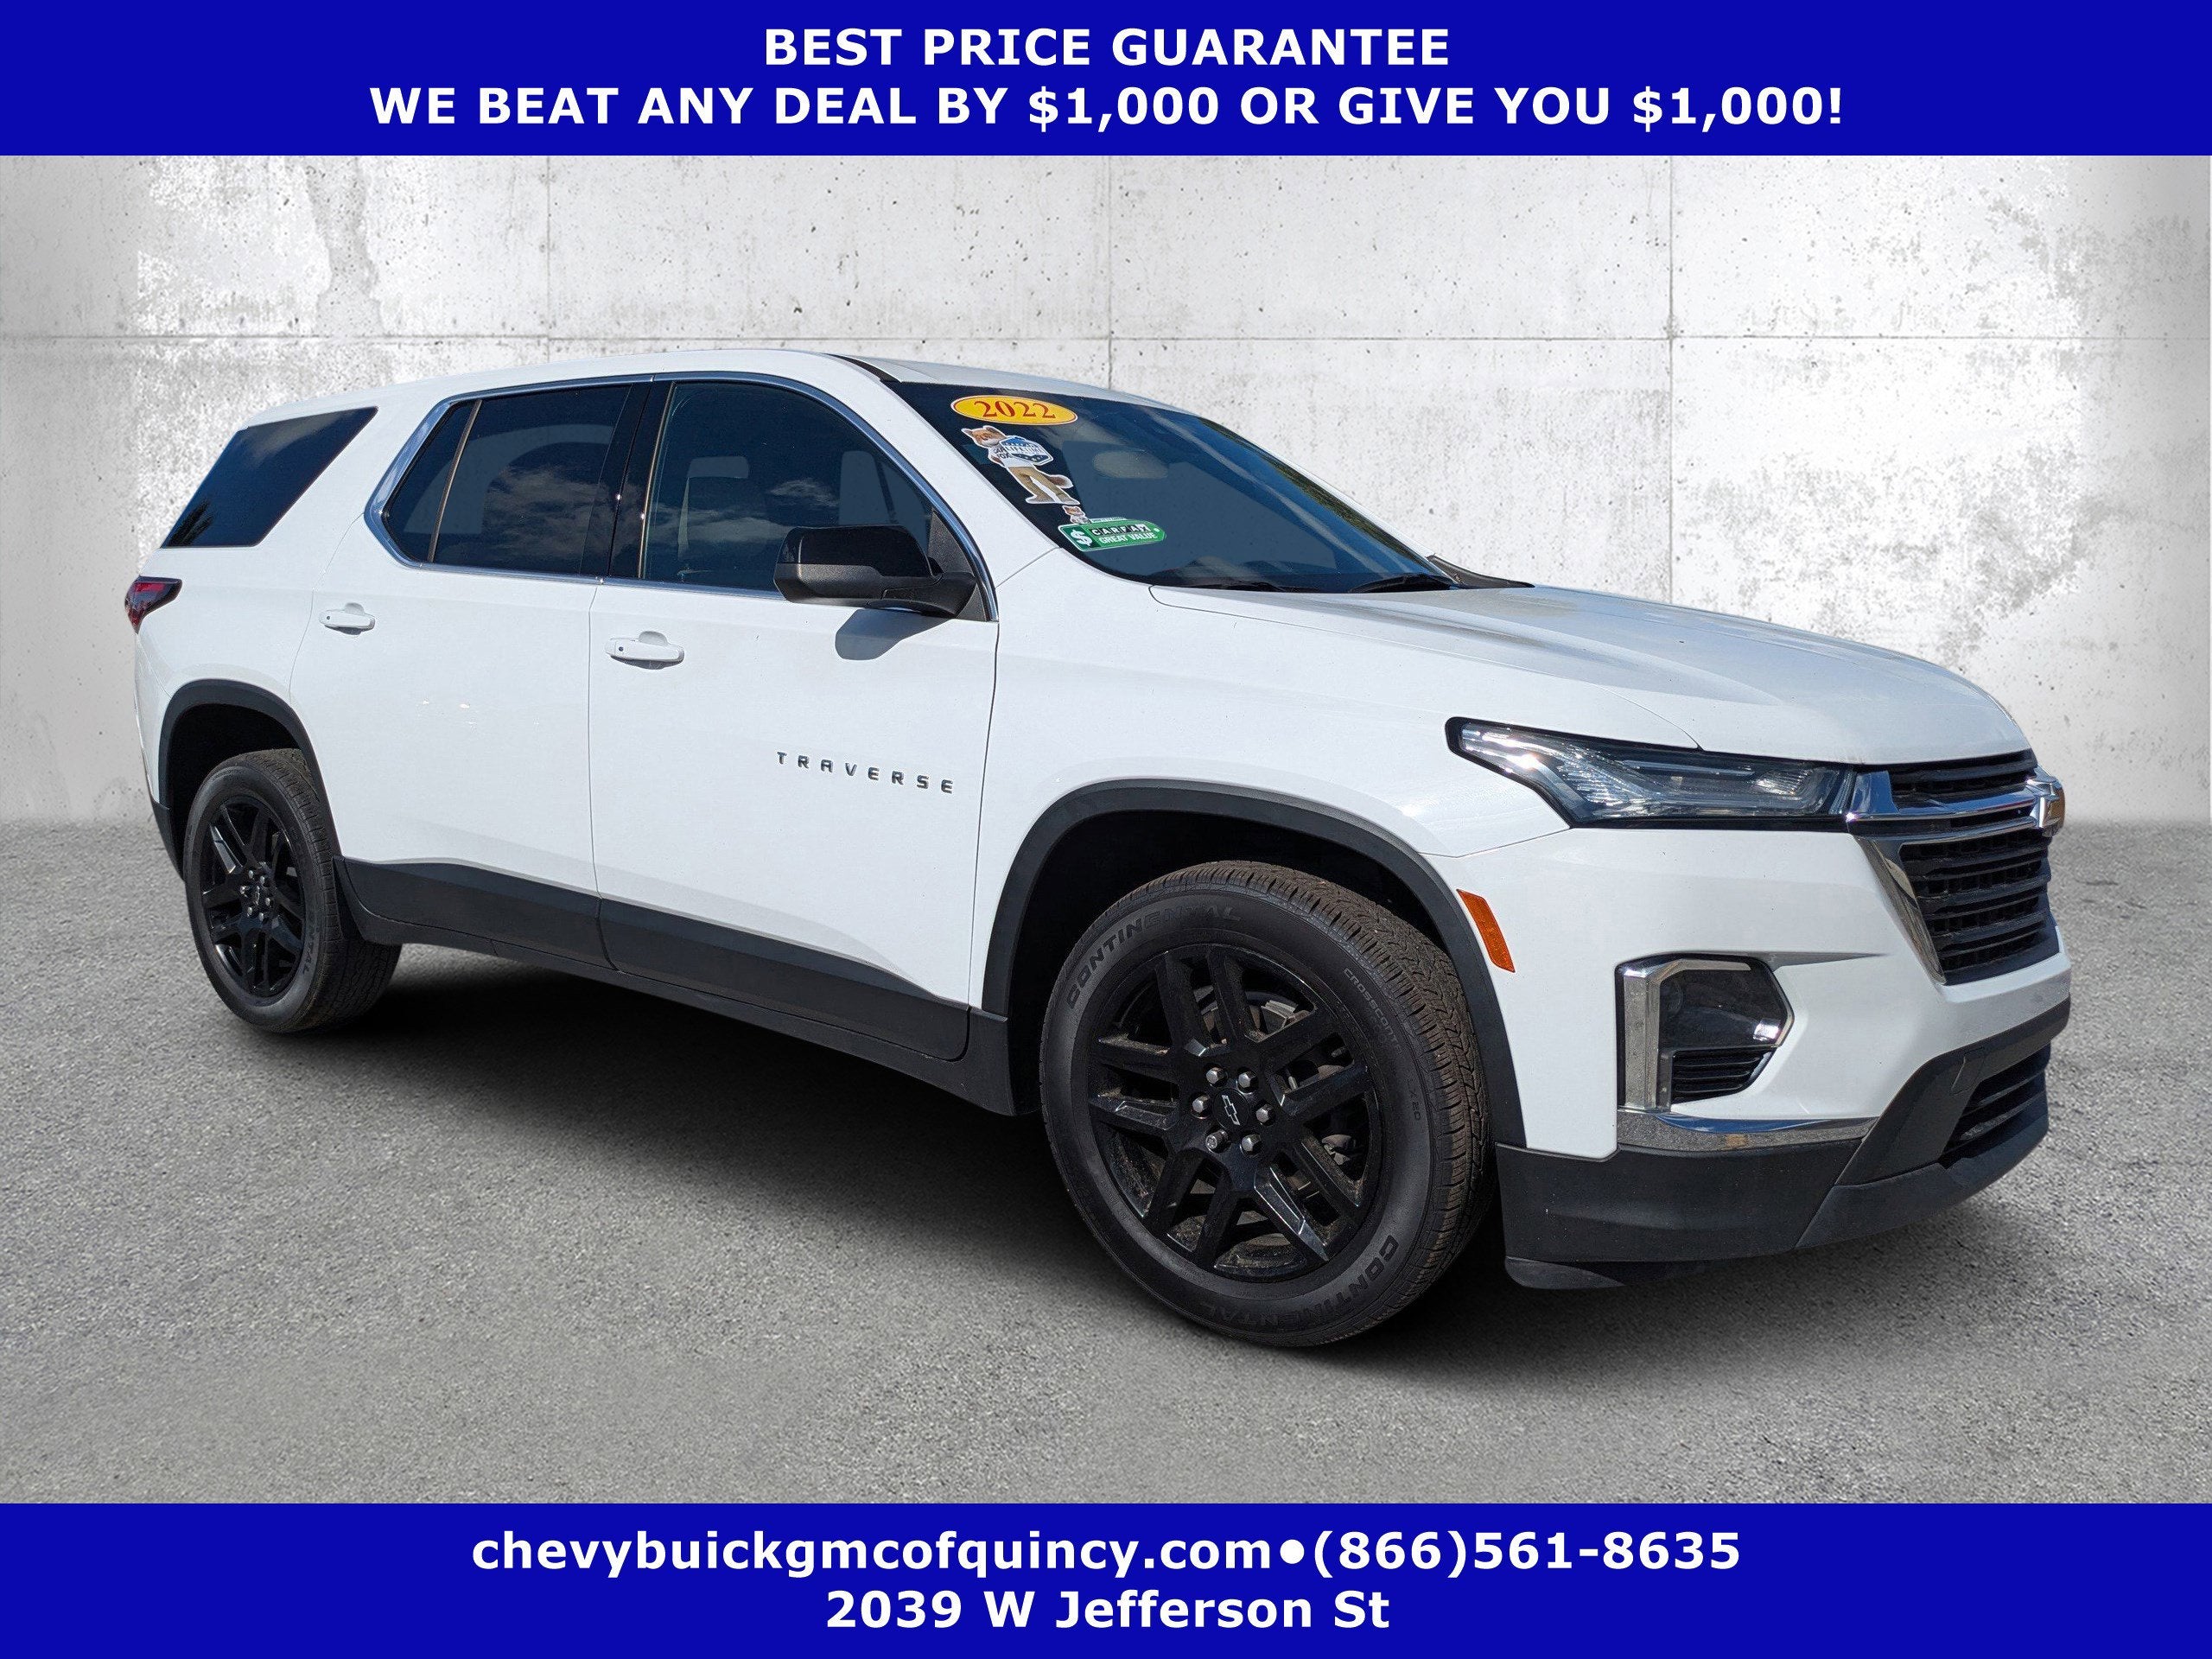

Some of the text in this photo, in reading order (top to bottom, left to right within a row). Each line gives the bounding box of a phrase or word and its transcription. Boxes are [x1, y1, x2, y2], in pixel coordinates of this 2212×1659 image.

[973, 399, 1057, 419] 2022
[1090, 524, 1151, 536] CARFAX
[1098, 532, 1158, 544] GREAT VALUE
[777, 752, 953, 794] TRAVERSE
[1065, 905, 1244, 1010] CONTINENTAL
